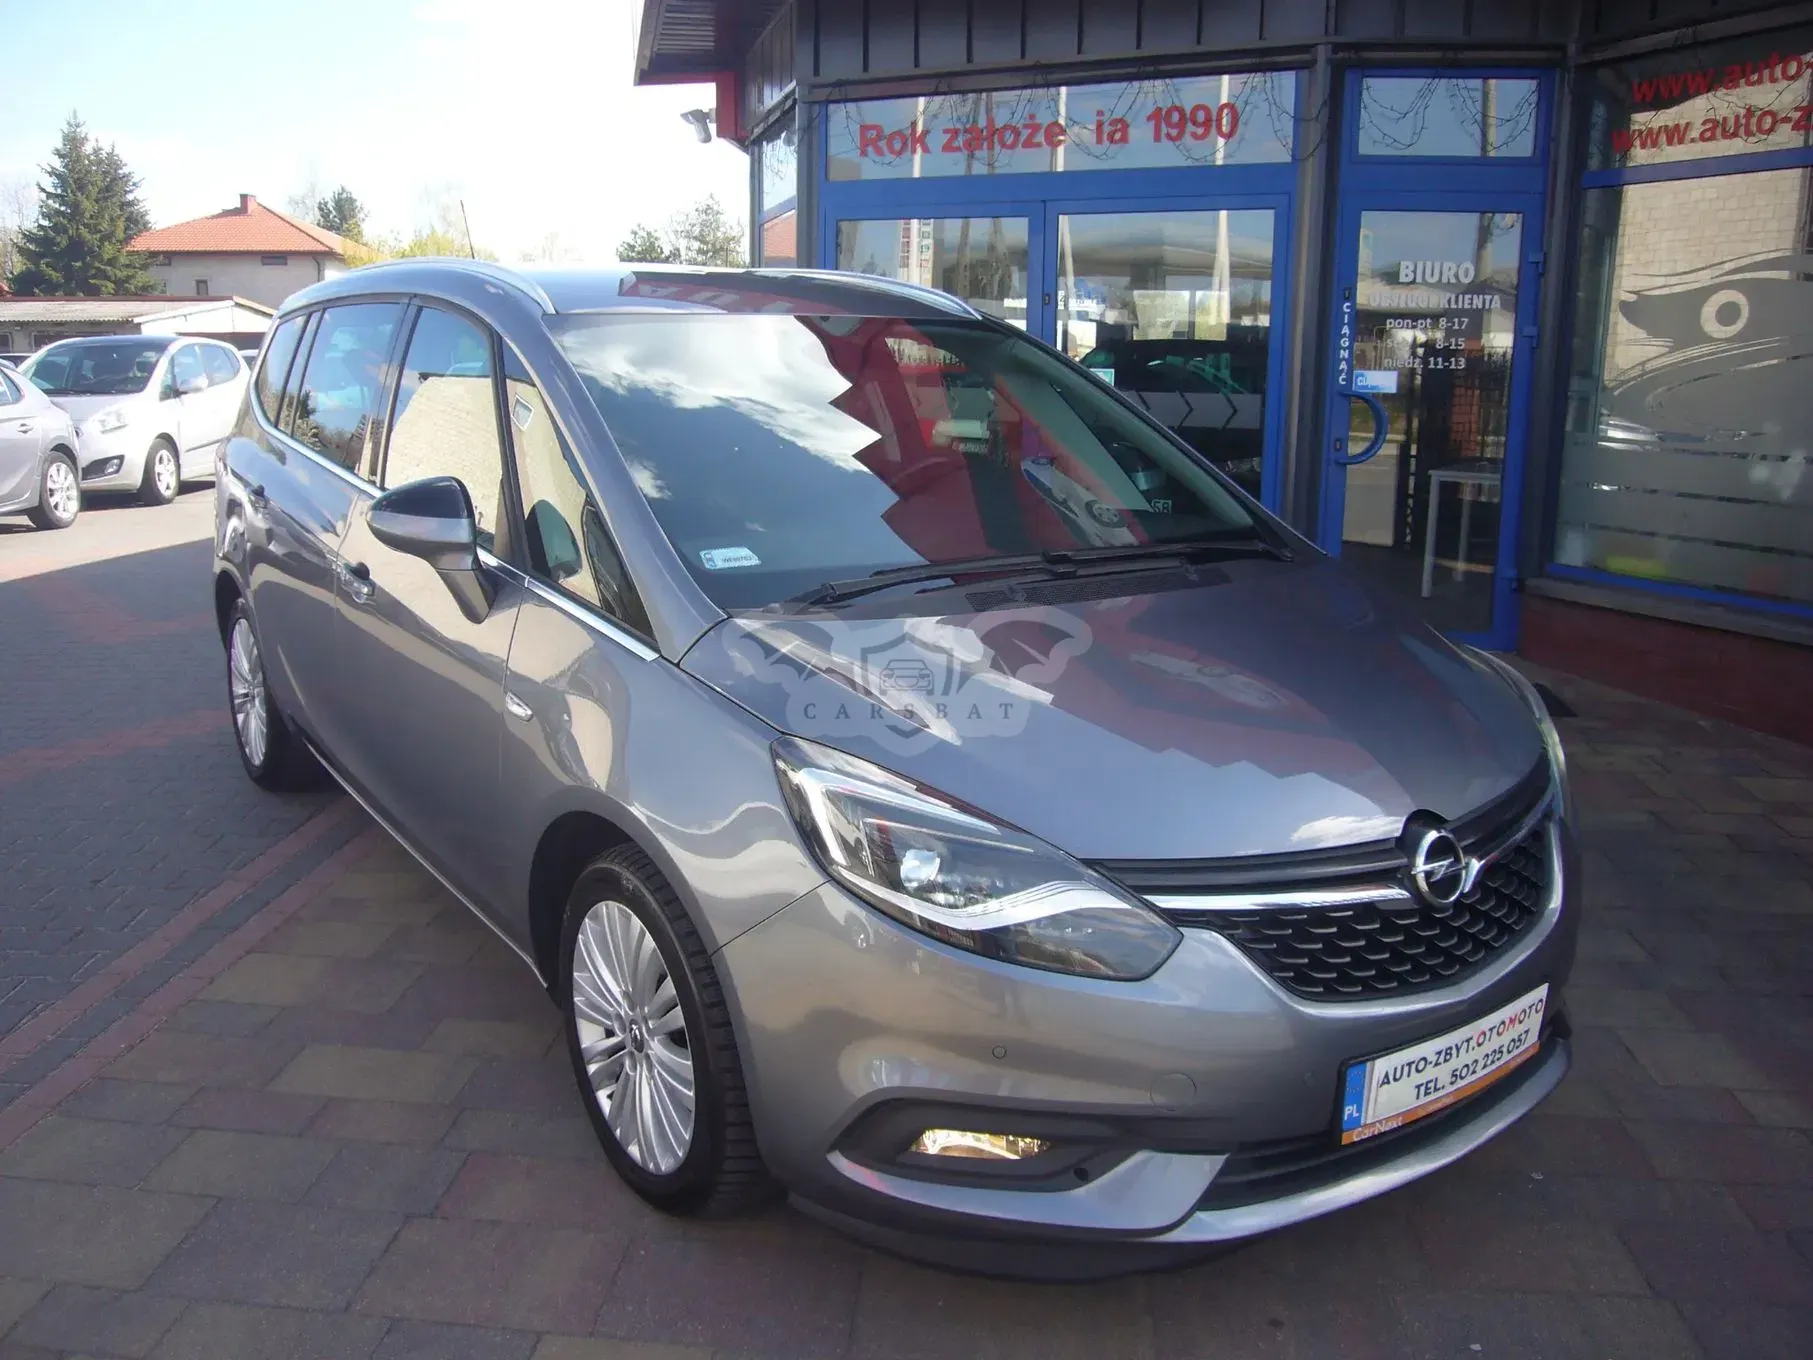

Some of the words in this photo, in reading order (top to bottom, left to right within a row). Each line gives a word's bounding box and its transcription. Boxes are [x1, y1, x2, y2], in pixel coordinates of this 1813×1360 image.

[859, 123, 931, 157] Rok
[1146, 102, 1240, 143] 1990
[1399, 260, 1475, 284] BIURO
[1440, 293, 1501, 310] KLIENTA
[1386, 317, 1432, 330] pon-pt
[1438, 317, 1469, 330] 8-17
[1435, 337, 1465, 350] 8-15
[1427, 356, 1466, 370] 11-13
[1379, 998, 1544, 1088] AUTO-ZBYT.OTOMOTO
[1414, 1078, 1446, 1100] TEL.
[1449, 1057, 1479, 1085] 502
[1480, 1046, 1505, 1070] 225
[1506, 1027, 1531, 1053] 057
[1343, 1105, 1360, 1120] PL
